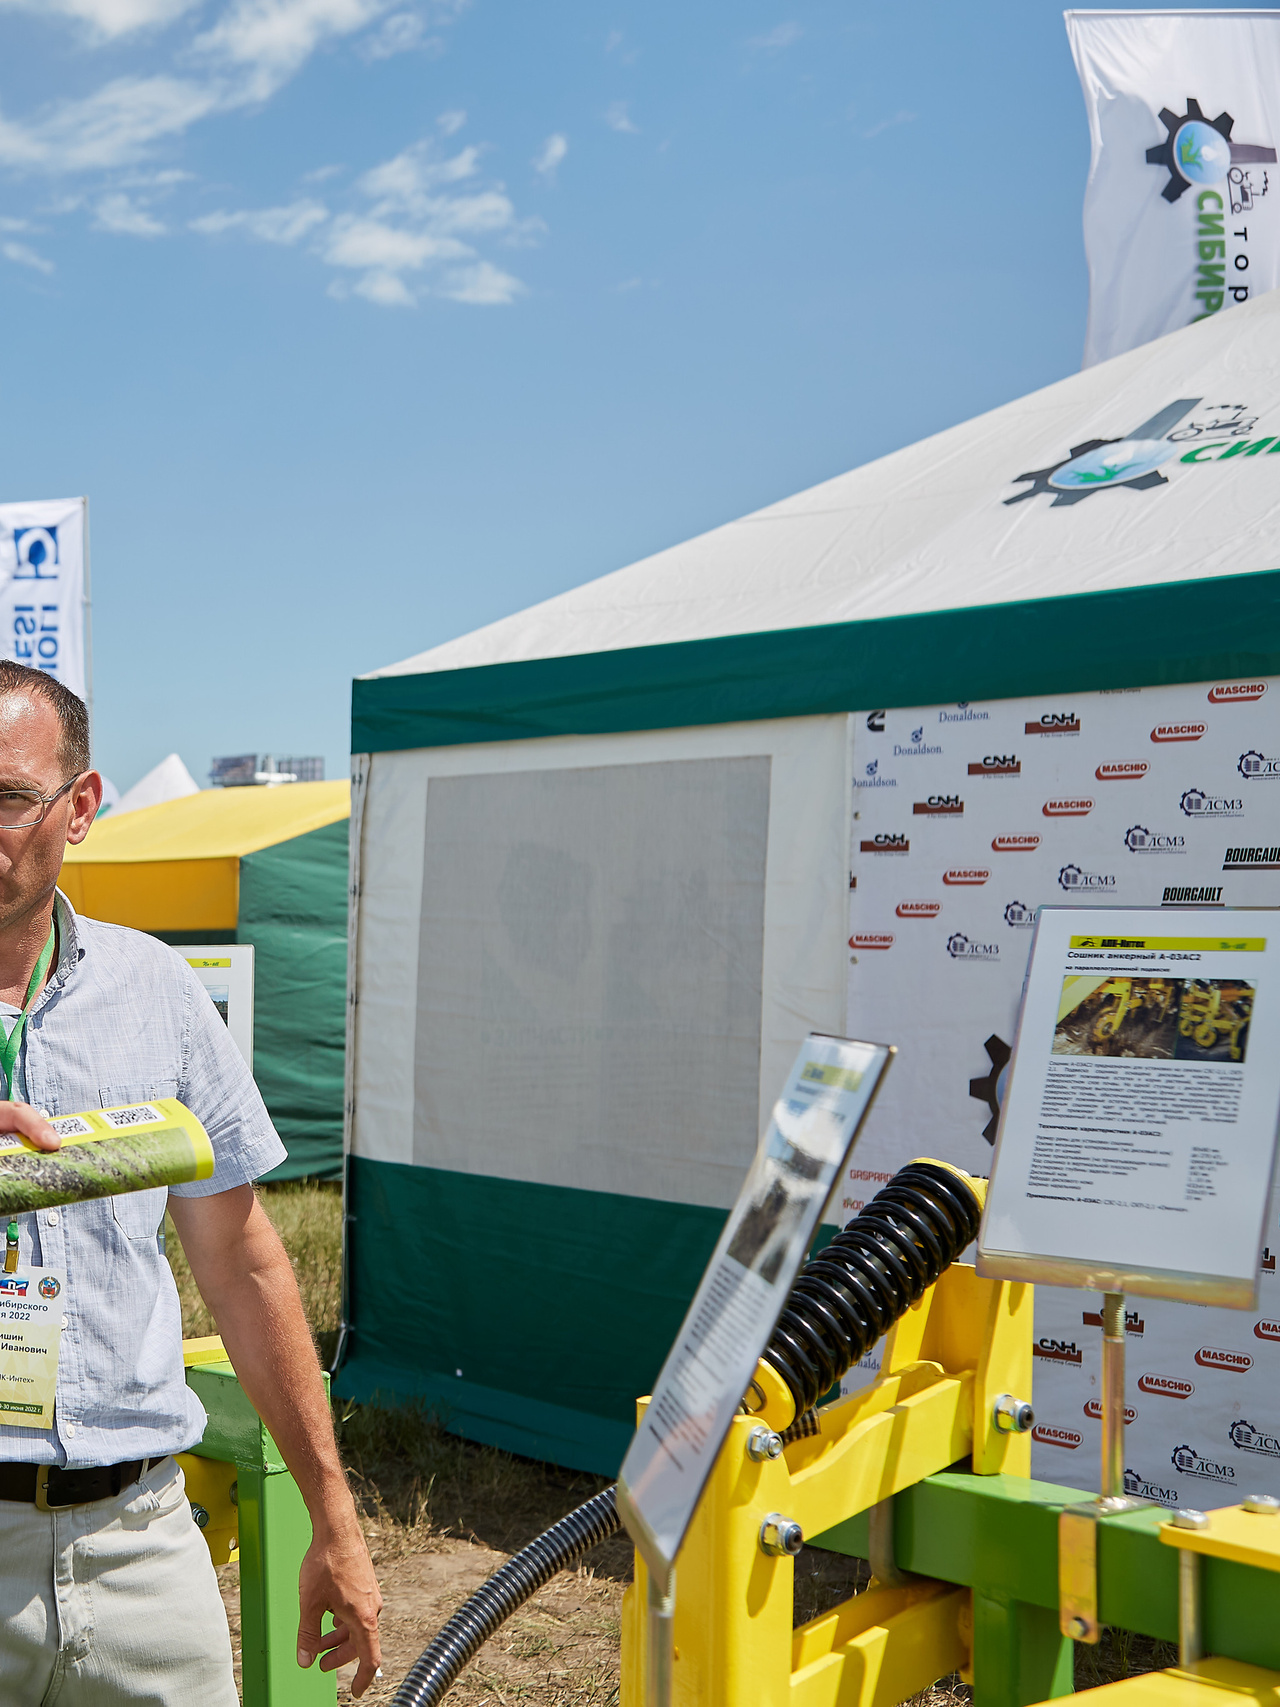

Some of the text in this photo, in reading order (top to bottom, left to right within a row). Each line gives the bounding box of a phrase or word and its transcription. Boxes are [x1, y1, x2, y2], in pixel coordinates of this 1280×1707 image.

[1191, 190, 1226, 324] СИБИР
[1180, 436, 1280, 464] СИ
[1215, 682, 1265, 696] MASCHIO
[939, 709, 989, 723] Donaldson
[1041, 712, 1075, 725] CNH
[1157, 723, 1205, 736] MASCHIO
[894, 743, 942, 756] Donaldson
[983, 755, 1016, 767] CNH
[1101, 762, 1148, 774] MASCHIO
[927, 794, 960, 807] CNH
[1048, 799, 1092, 811] MASCHIO
[1204, 799, 1243, 811] ЛСМЗ
[874, 833, 906, 845] CNH
[998, 835, 1040, 846] MASCHIO
[1224, 847, 1280, 863] BOURGAU
[948, 869, 990, 881] MASCHIO
[1162, 886, 1224, 903] BOURGAULT
[901, 902, 940, 913] MASCHIO
[855, 934, 894, 945] MASCHIO
[1067, 951, 1105, 960] Сошник
[1107, 952, 1156, 961] анкерный
[9, 1311, 31, 1321] 2022
[1, 1343, 48, 1355] Иванович
[1039, 1338, 1076, 1353] CNH
[1202, 1349, 1250, 1366] MASCHIO
[1145, 1376, 1192, 1393] MASCHIO
[1090, 1402, 1135, 1419] MAIO
[1037, 1427, 1081, 1443] MASCHIO
[1195, 1461, 1235, 1478] ЛСМЗ
[1140, 1485, 1179, 1501] ЛСМЗ
